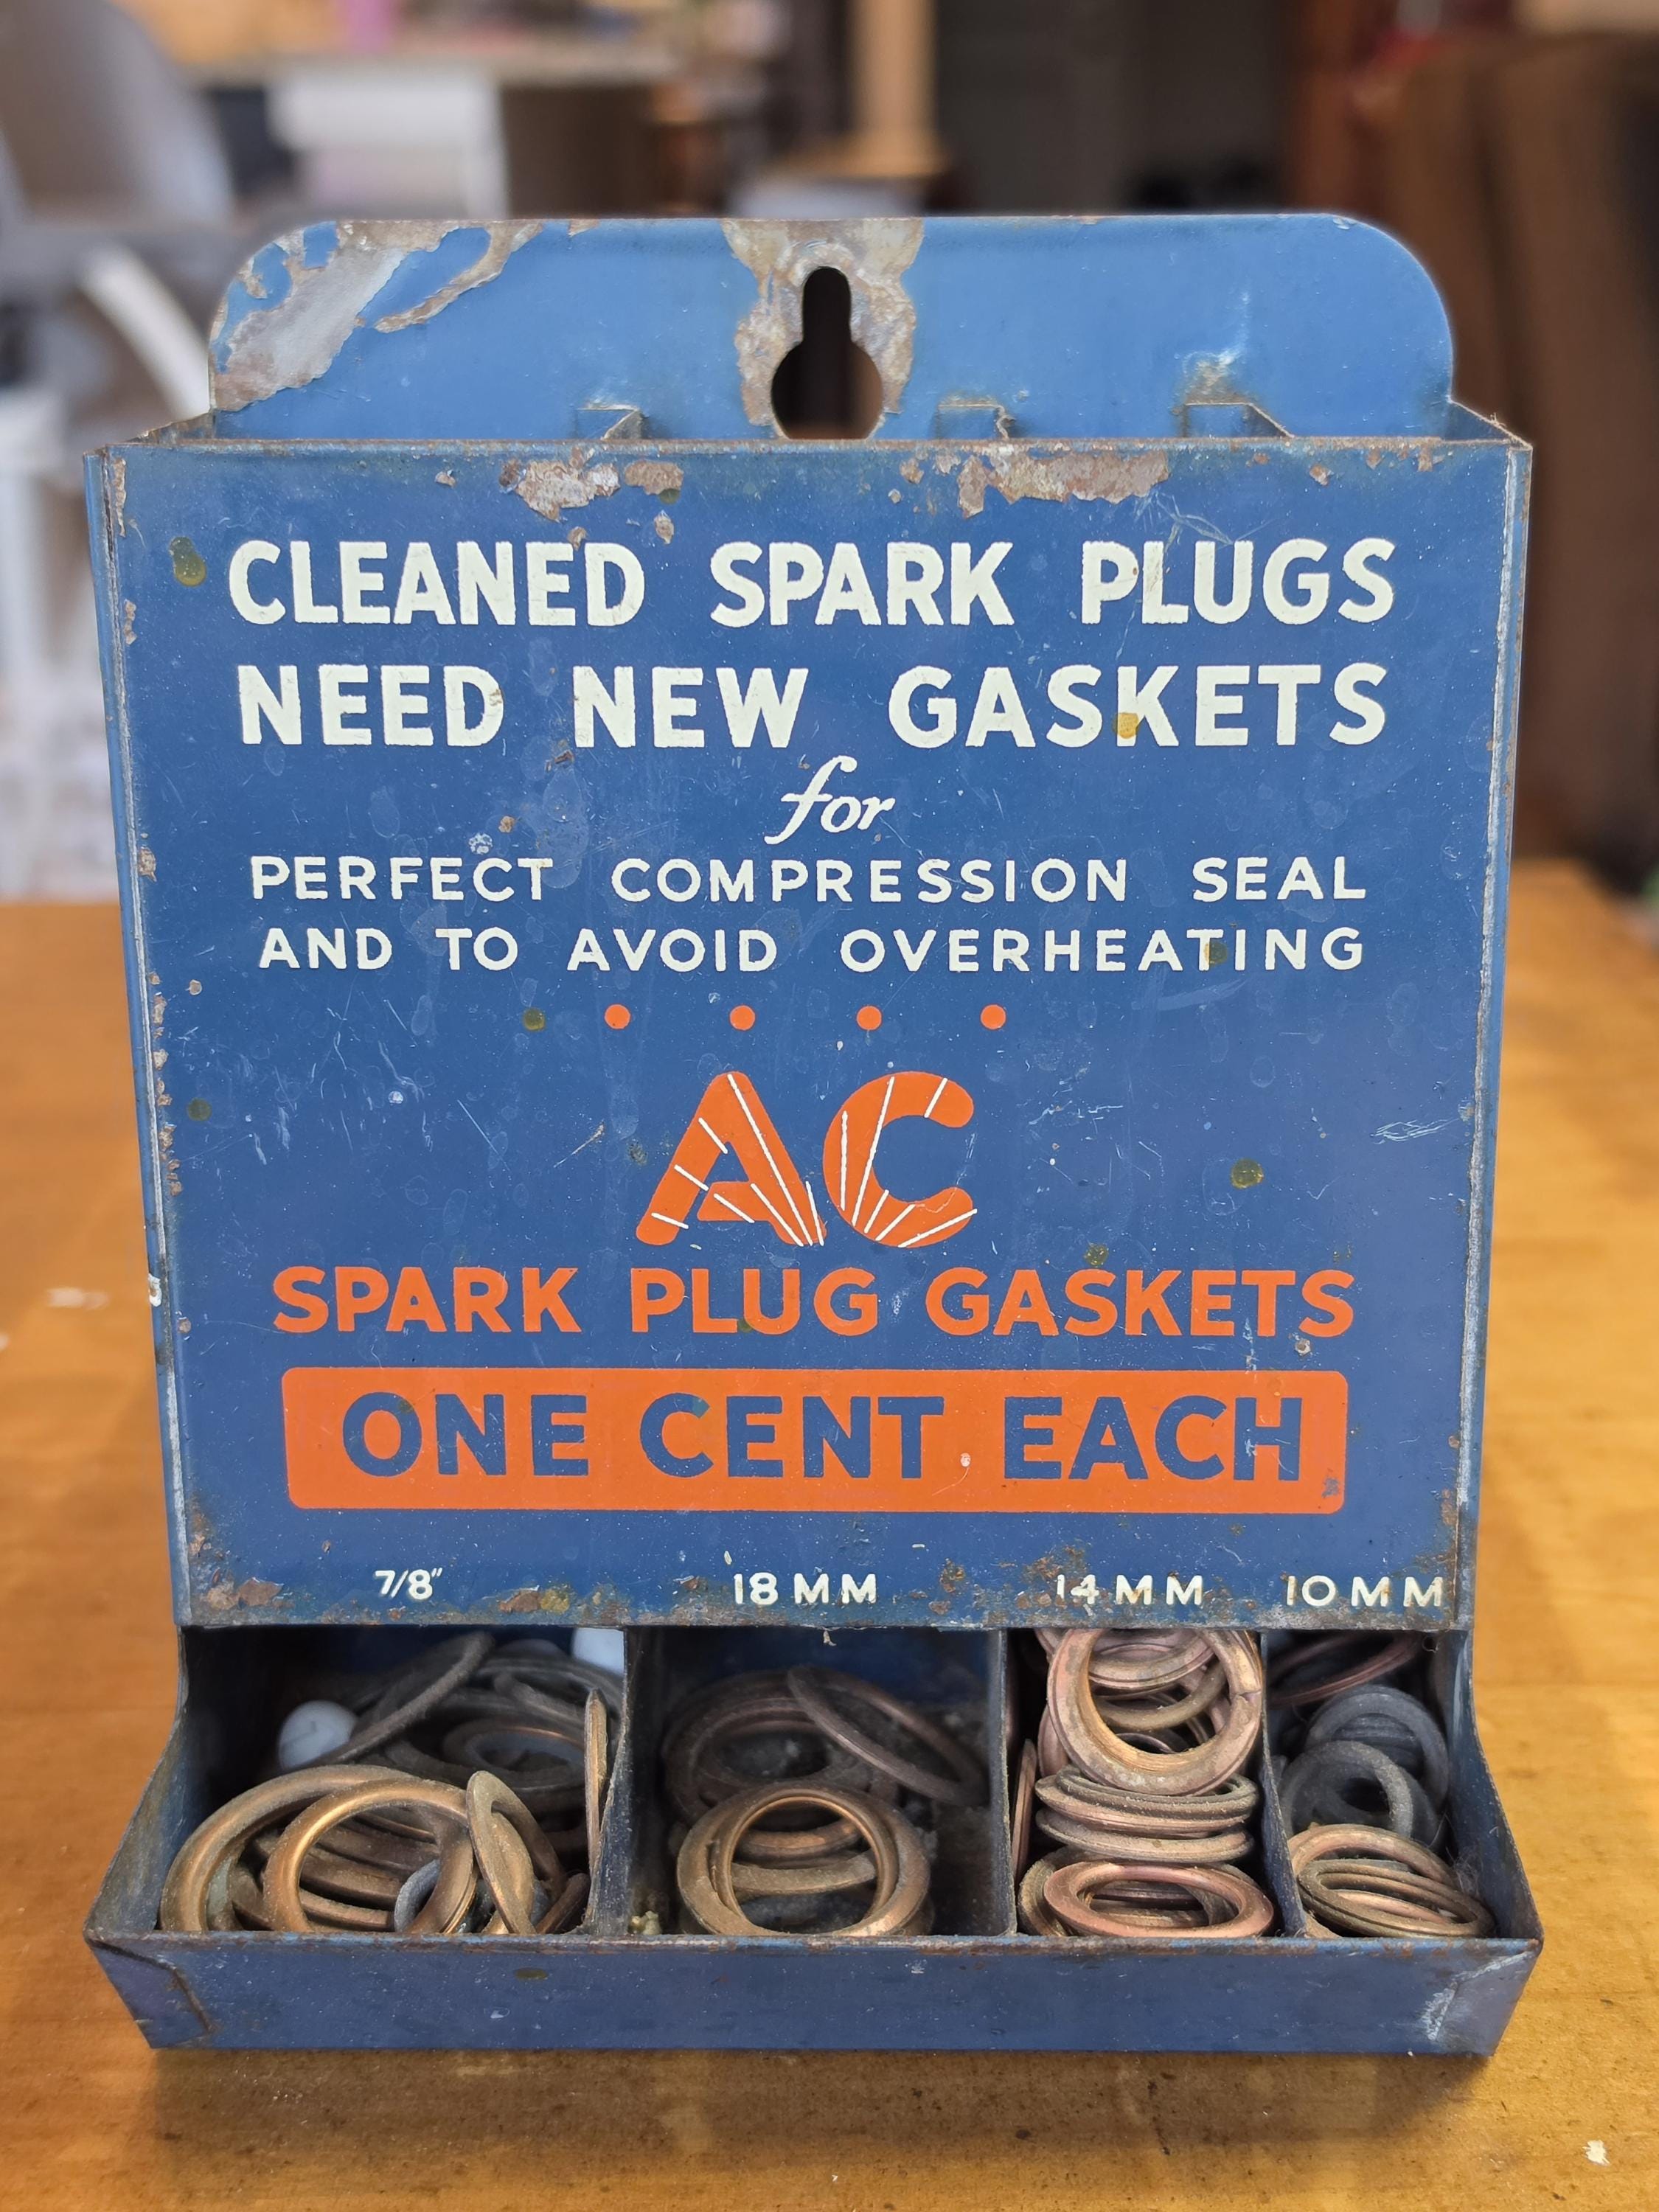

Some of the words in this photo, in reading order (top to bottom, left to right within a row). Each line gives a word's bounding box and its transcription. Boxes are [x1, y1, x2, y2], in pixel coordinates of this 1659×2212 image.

[229, 540, 645, 627] CLEANED
[710, 541, 1015, 627] SPARK
[1081, 538, 1395, 625] PLUGS
[237, 664, 504, 747] NEED
[572, 666, 809, 748] NEW
[888, 662, 1387, 748] GASKETS
[764, 755, 896, 845] for
[251, 855, 553, 902] PERFECT
[611, 858, 1127, 903] COMPRESSION
[1192, 856, 1366, 902] SEAL
[259, 928, 392, 970] AND
[435, 926, 518, 971] TO
[567, 928, 777, 973] AVOID
[840, 927, 1363, 973] OVERHEATING
[636, 1071, 977, 1248] AC
[274, 1267, 580, 1333] SPARK
[631, 1268, 878, 1336] PLUG
[926, 1268, 1354, 1338] GASKETS
[341, 1391, 591, 1478] ONE
[639, 1392, 946, 1480] CENT
[1004, 1394, 1304, 1483] EACH
[375, 1568, 443, 1601] 7/8"
[734, 1572, 779, 1605] 18
[793, 1573, 877, 1604] MM
[1057, 1574, 1100, 1605] 14
[1116, 1574, 1203, 1606] MM
[1287, 1575, 1337, 1608] 10
[1351, 1576, 1444, 1607] MM
